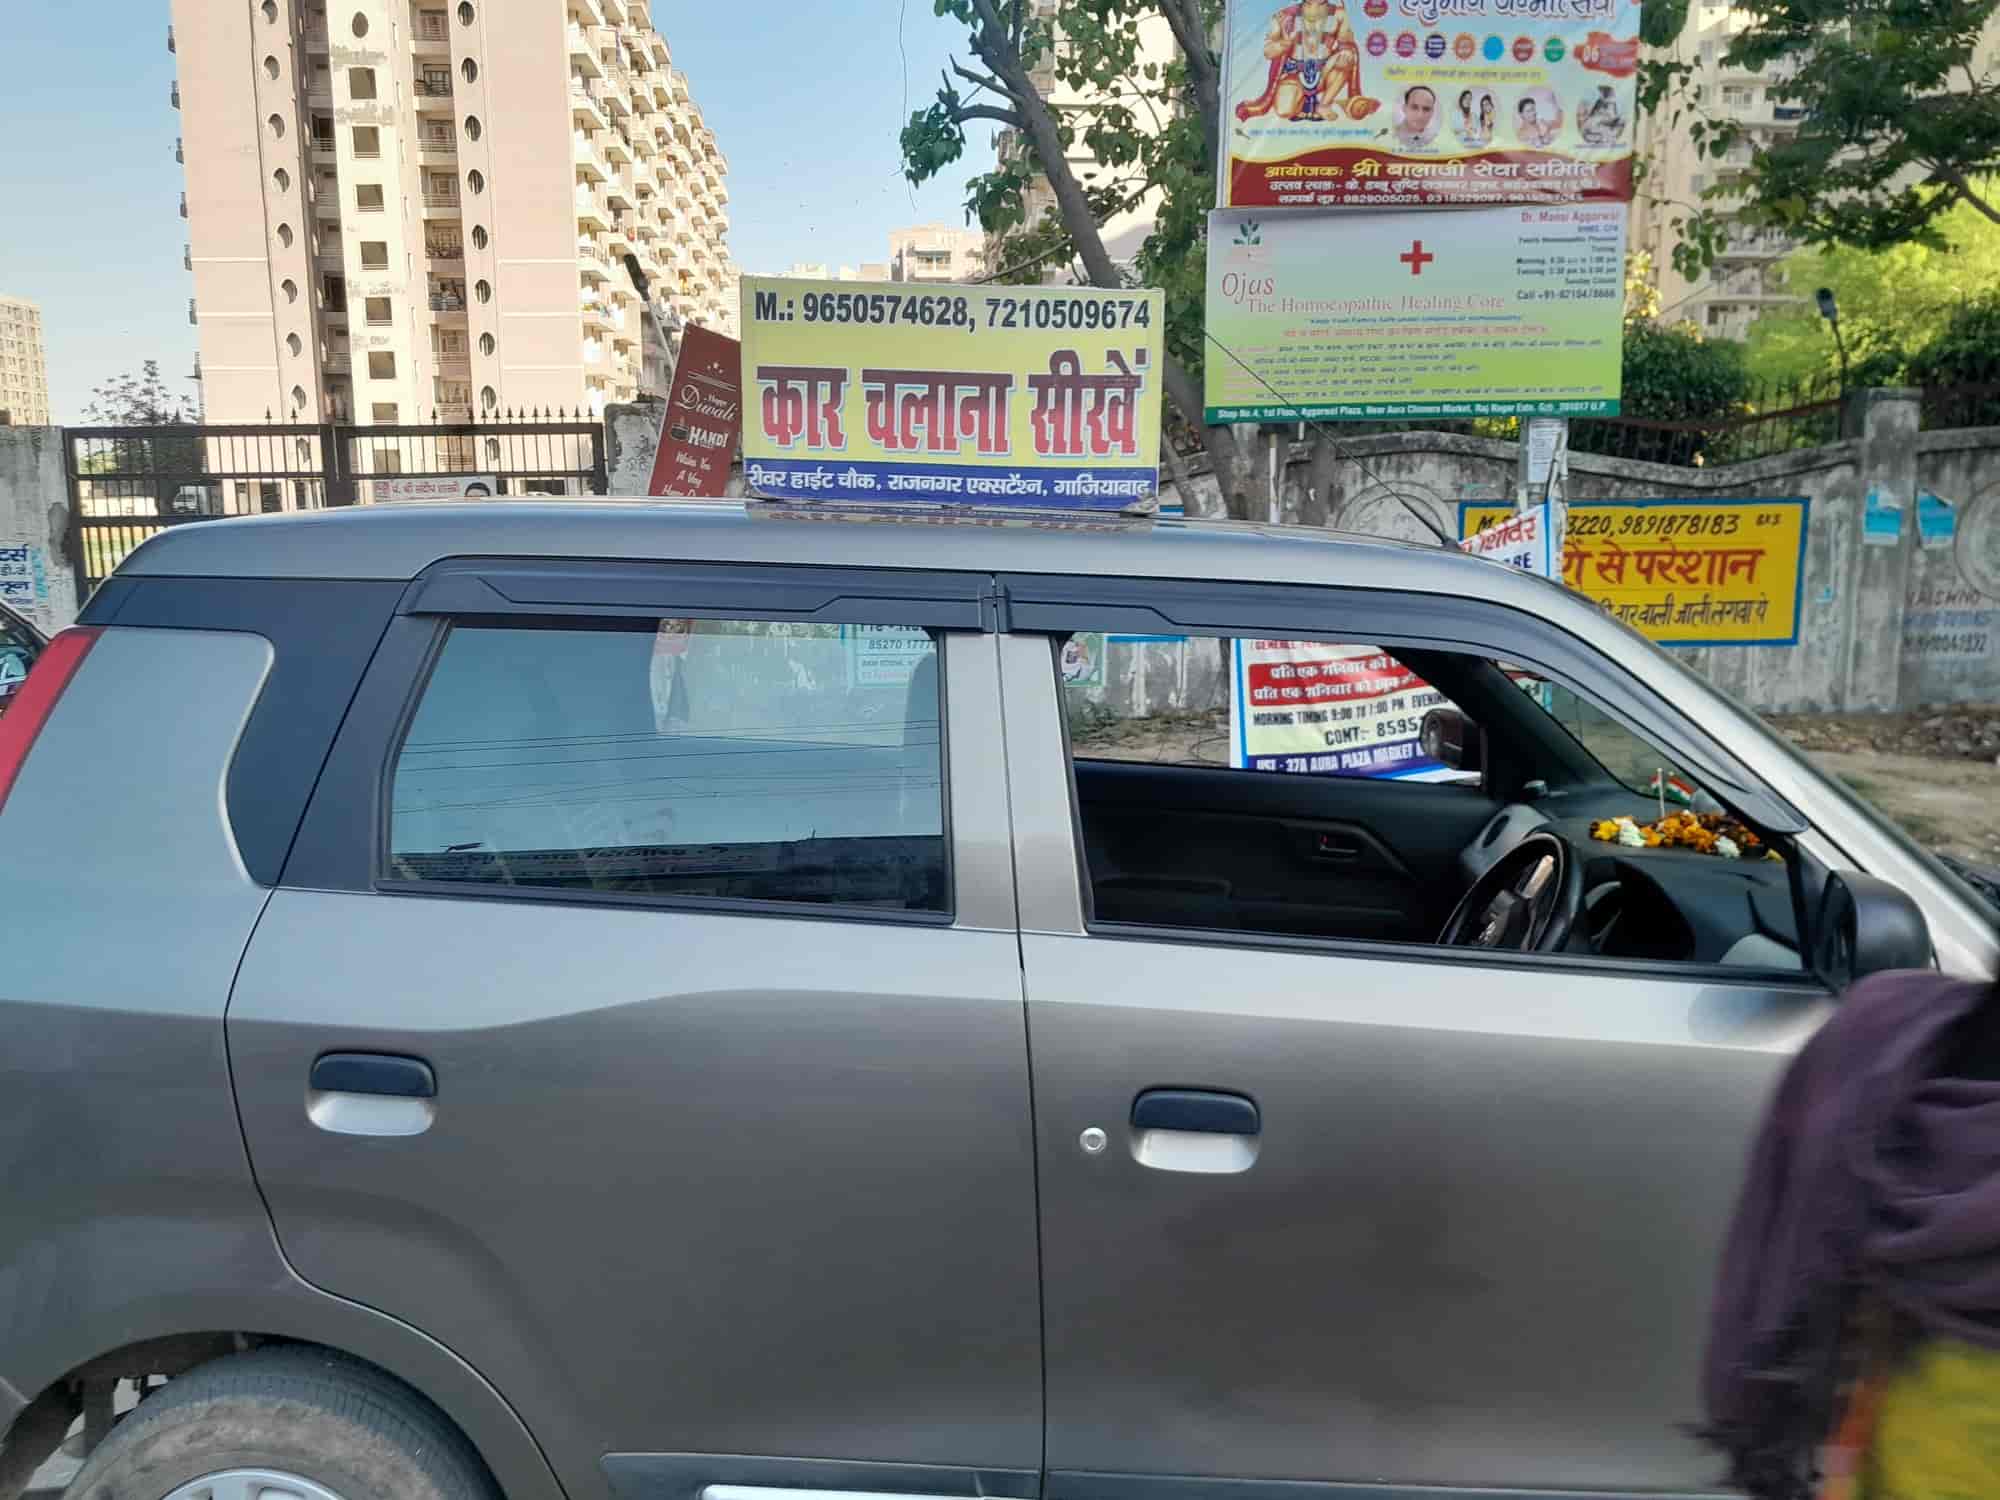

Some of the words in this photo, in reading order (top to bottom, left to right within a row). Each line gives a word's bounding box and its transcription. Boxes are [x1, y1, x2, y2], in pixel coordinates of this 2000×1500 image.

[1352, 158, 1381, 177] श्री
[1387, 160, 1465, 177] बालाजी
[1473, 160, 1519, 177] सेवा
[1526, 159, 1599, 177] समिति
[1221, 272, 1275, 304] Ojas
[802, 292, 976, 334] 9650574628,
[985, 299, 1151, 330] 7210509674
[1248, 298, 1274, 313] The
[756, 365, 850, 450] कार
[861, 367, 1014, 454] चलाना
[1027, 347, 1149, 456] सीखें
[747, 464, 787, 492] रीवर
[790, 466, 834, 490] हाईट
[837, 467, 882, 491] चौक,
[887, 473, 964, 492] राजनगर
[1596, 537, 1631, 585] से
[1632, 536, 1766, 586] परेशान
[1297, 663, 1317, 679] एक
[1281, 685, 1302, 699] एक
[1253, 711, 1293, 726] MORNING
[1297, 709, 1329, 724] TIMING
[1391, 698, 1404, 712] PM
[1341, 749, 1372, 769] PLAZA
